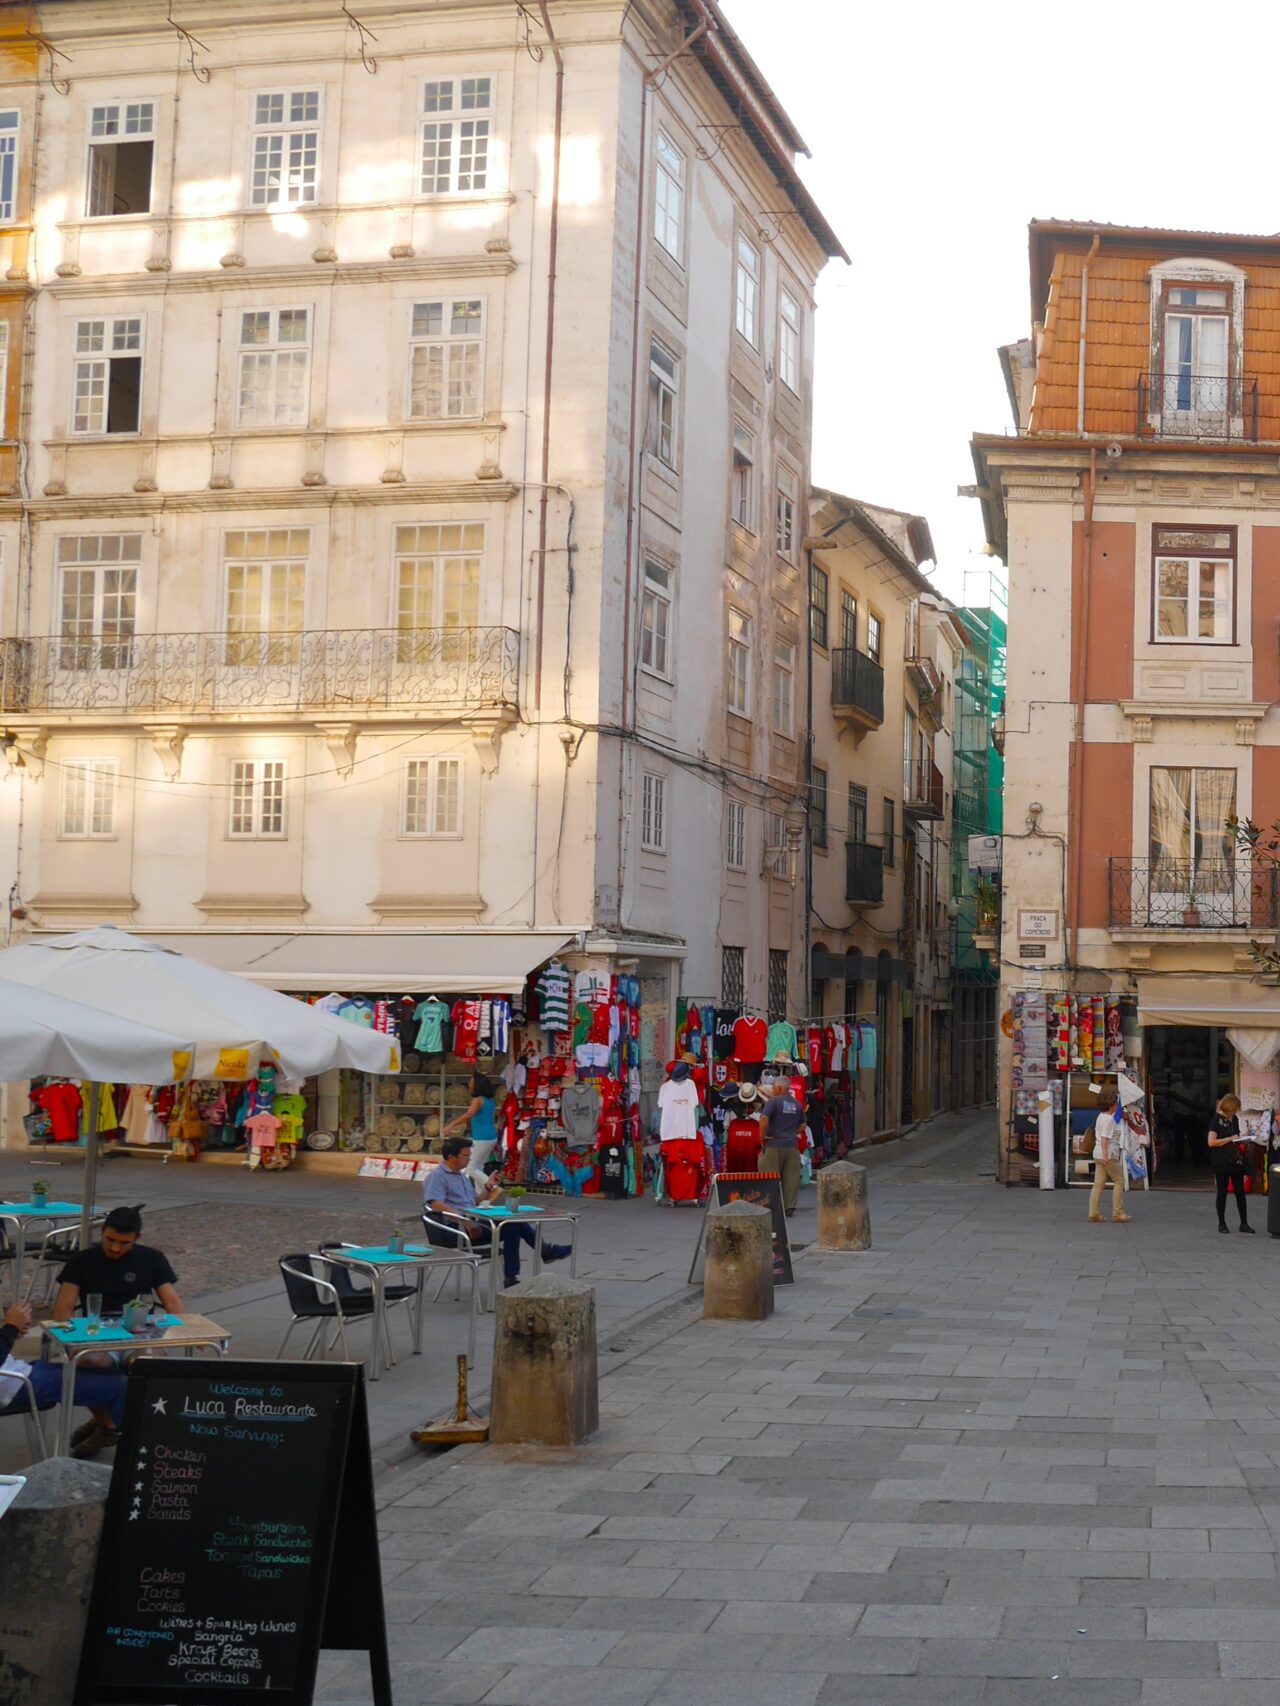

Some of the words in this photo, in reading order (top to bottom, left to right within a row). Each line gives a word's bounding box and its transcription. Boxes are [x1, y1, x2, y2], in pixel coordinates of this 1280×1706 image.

[812, 1044, 818, 1062] 7
[210, 1383, 264, 1397] Welcome
[271, 1385, 283, 1397] to
[184, 1396, 226, 1415] Luca
[235, 1397, 318, 1417] Restaurante
[190, 1424, 219, 1435] Now
[154, 1445, 207, 1463] Chicken
[153, 1461, 203, 1479] Steaks
[151, 1480, 198, 1494] Salmon
[151, 1494, 189, 1508] Pasta
[147, 1507, 192, 1520] Salads
[140, 1568, 185, 1583] Cakes
[237, 1564, 283, 1580] Tapas
[140, 1585, 180, 1599] Tarts
[137, 1599, 185, 1613] Cookies
[261, 1620, 296, 1632] Wines
[194, 1631, 244, 1646] Sangria
[223, 1645, 259, 1659] Beers
[168, 1654, 216, 1667] Special
[185, 1669, 250, 1684] Cocktails
